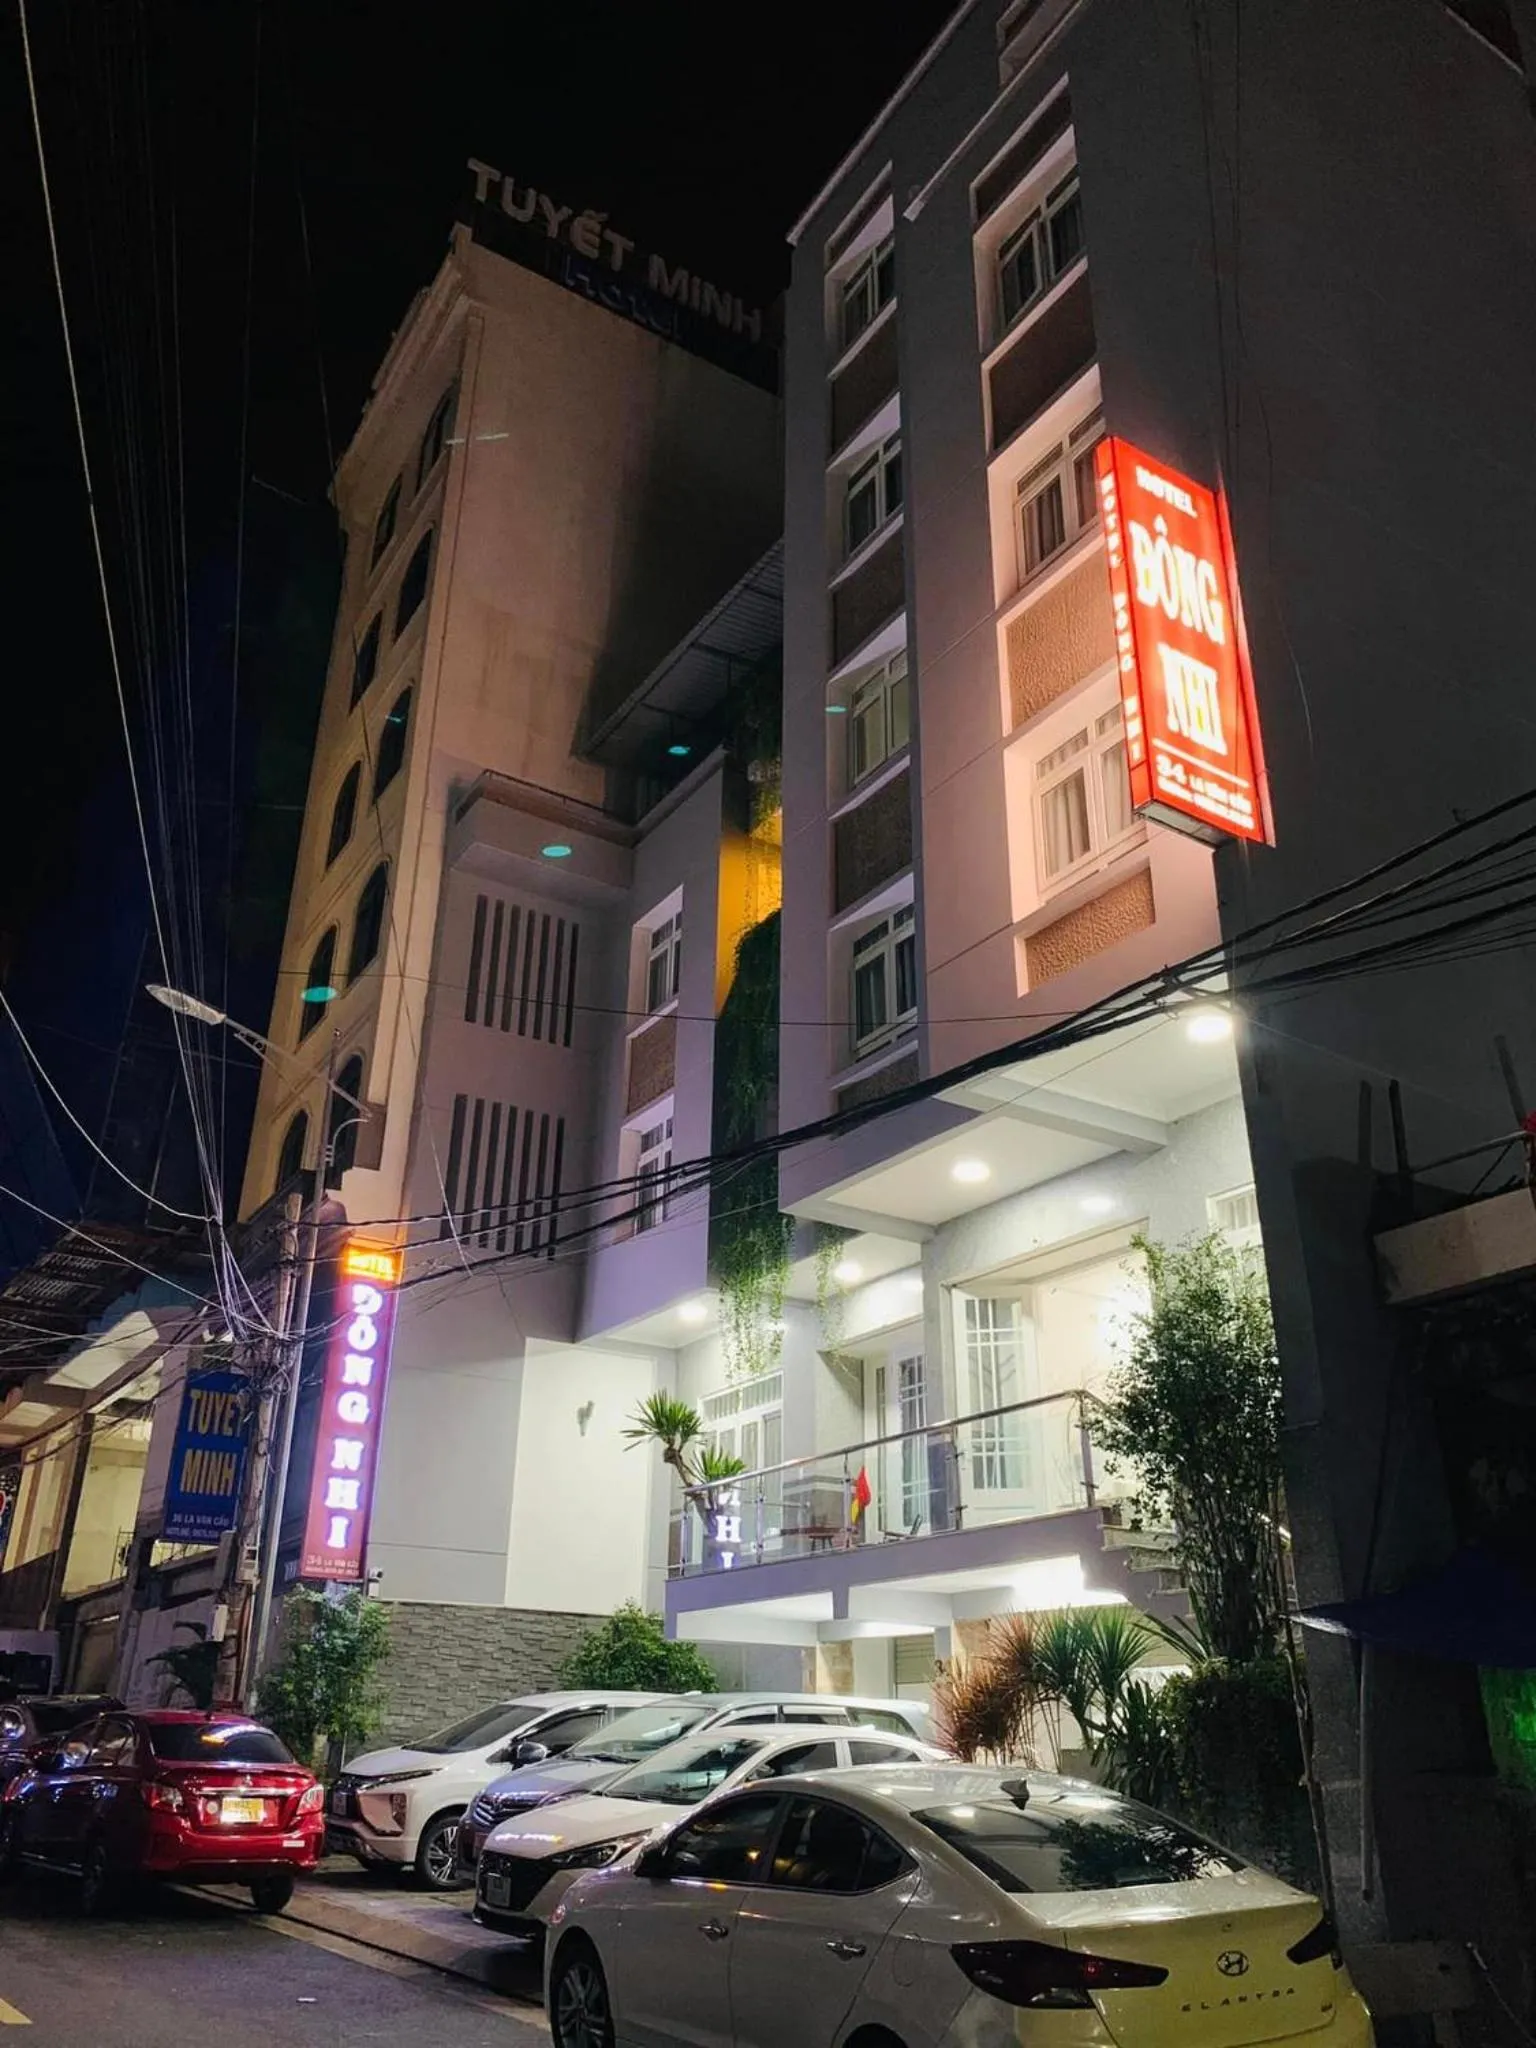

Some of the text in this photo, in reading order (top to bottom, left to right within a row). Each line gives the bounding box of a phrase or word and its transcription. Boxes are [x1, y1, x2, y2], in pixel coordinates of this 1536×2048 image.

[467, 157, 762, 342] TUYẾT MINH
[180, 1448, 237, 1497] MINH
